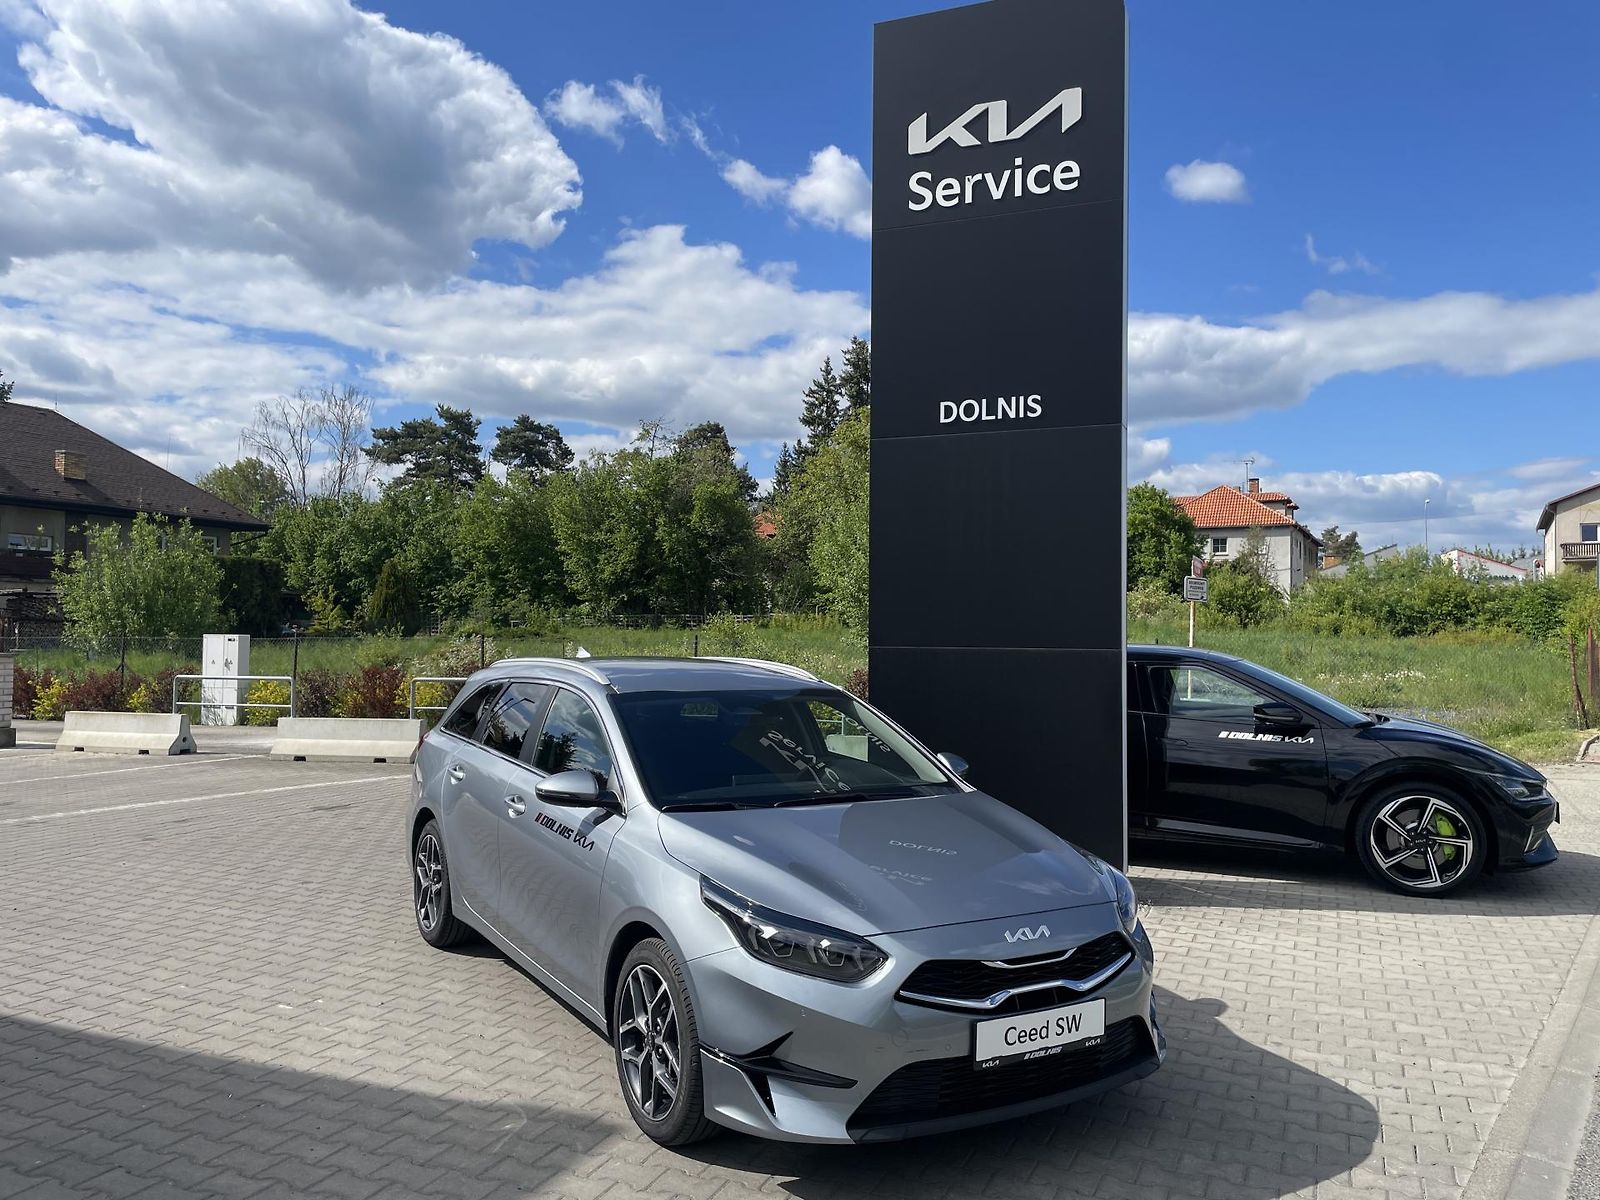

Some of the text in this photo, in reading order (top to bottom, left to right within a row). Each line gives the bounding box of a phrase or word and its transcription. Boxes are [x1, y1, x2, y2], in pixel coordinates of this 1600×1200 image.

[908, 87, 1083, 155] KIA
[908, 157, 1081, 211] Service
[939, 394, 1042, 423] DOLNIS
[1228, 731, 1284, 743] DOLNIS
[540, 814, 575, 840] DOLNIS
[1004, 924, 1051, 943] KIA
[1004, 1012, 1083, 1046] Ceed SW
